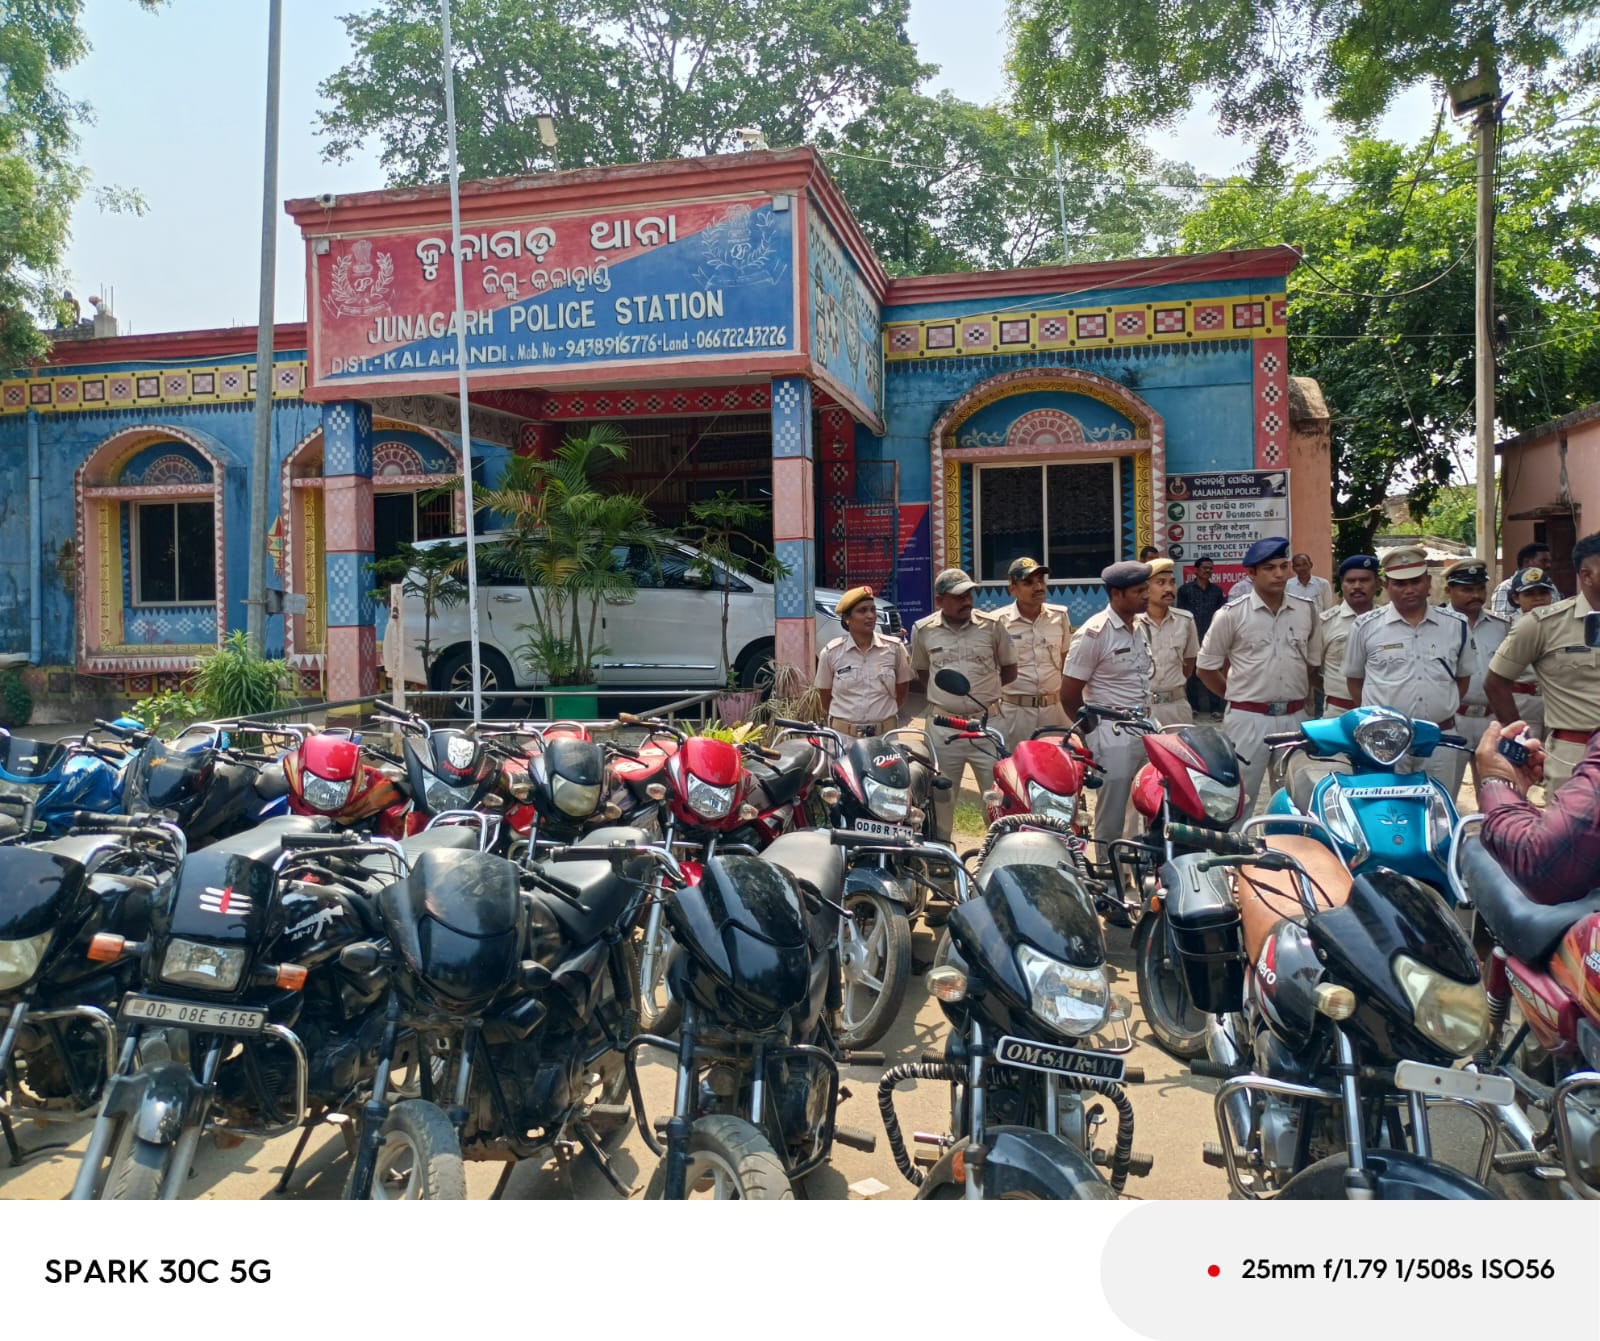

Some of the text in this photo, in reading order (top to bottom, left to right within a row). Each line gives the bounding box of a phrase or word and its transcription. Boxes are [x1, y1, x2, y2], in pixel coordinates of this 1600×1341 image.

[590, 214, 677, 250] ଥାନା
[368, 290, 725, 344] JUNAGARH POLICE STATION
[1192, 487, 1261, 497] KALAHANDI POLICE
[1196, 511, 1223, 520] CCTV
[1196, 533, 1222, 541] CCTV
[856, 821, 869, 831] OD
[146, 1003, 167, 1018] OD
[219, 1011, 257, 1027] 6165
[1007, 1043, 1042, 1064] OM
